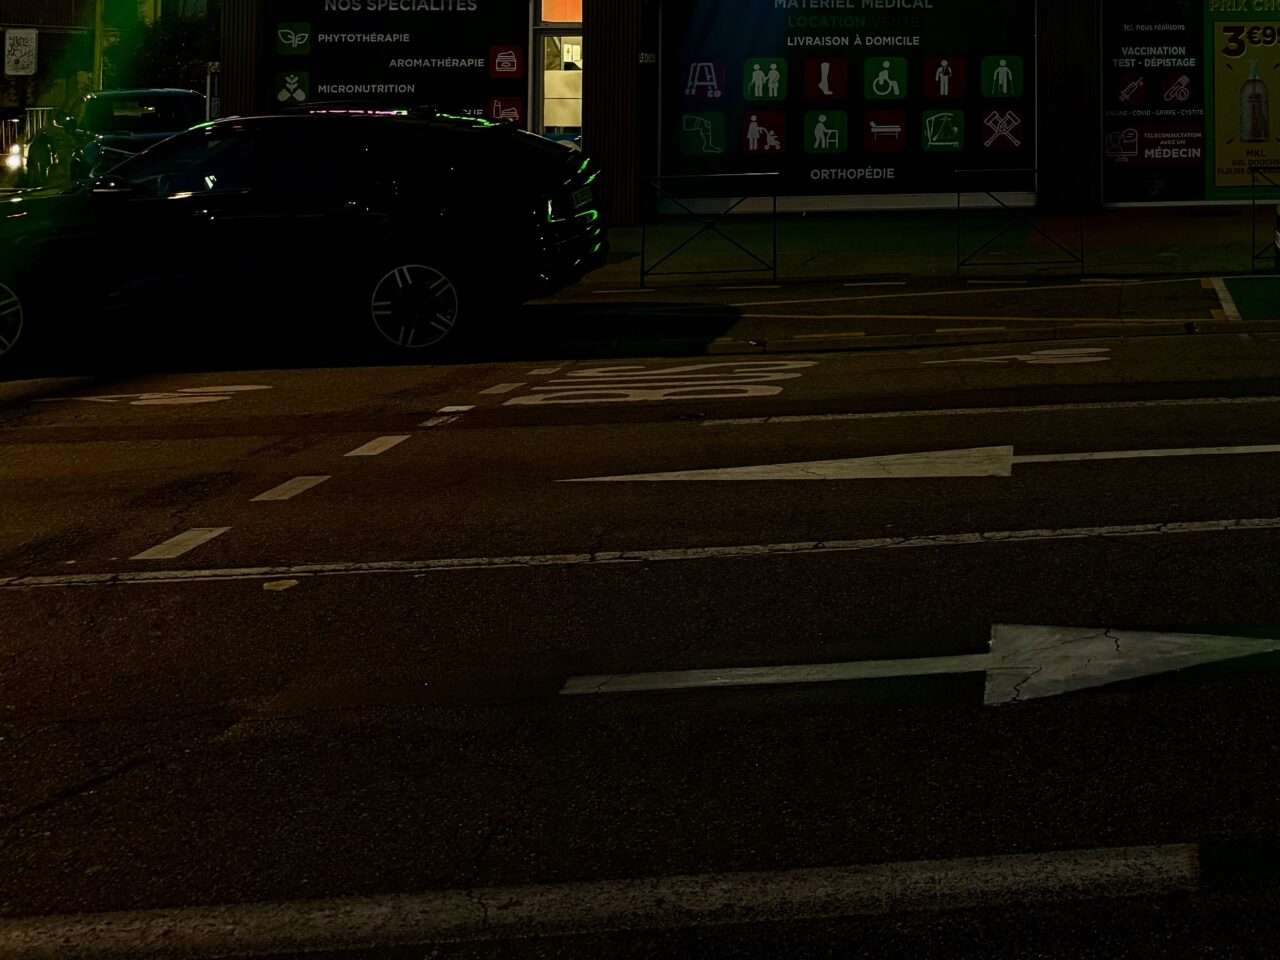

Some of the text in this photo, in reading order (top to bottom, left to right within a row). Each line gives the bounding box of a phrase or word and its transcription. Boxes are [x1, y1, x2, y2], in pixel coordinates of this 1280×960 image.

[787, 15, 866, 29] LOCATION
[317, 31, 411, 43] PHYTOTHÉRAPIE
[787, 34, 921, 46] LIVRAISON À DOMICILE
[1120, 46, 1186, 56] VACCINATION
[388, 55, 485, 69] AROMATHÉRAPIE
[1112, 58, 1137, 68] TEST
[1144, 55, 1196, 68] DÉPISTAGE
[317, 83, 416, 94] MICRONUTRITION
[1144, 146, 1201, 158] MÉDECIN
[810, 165, 896, 180] ORTHOPÉDIE
